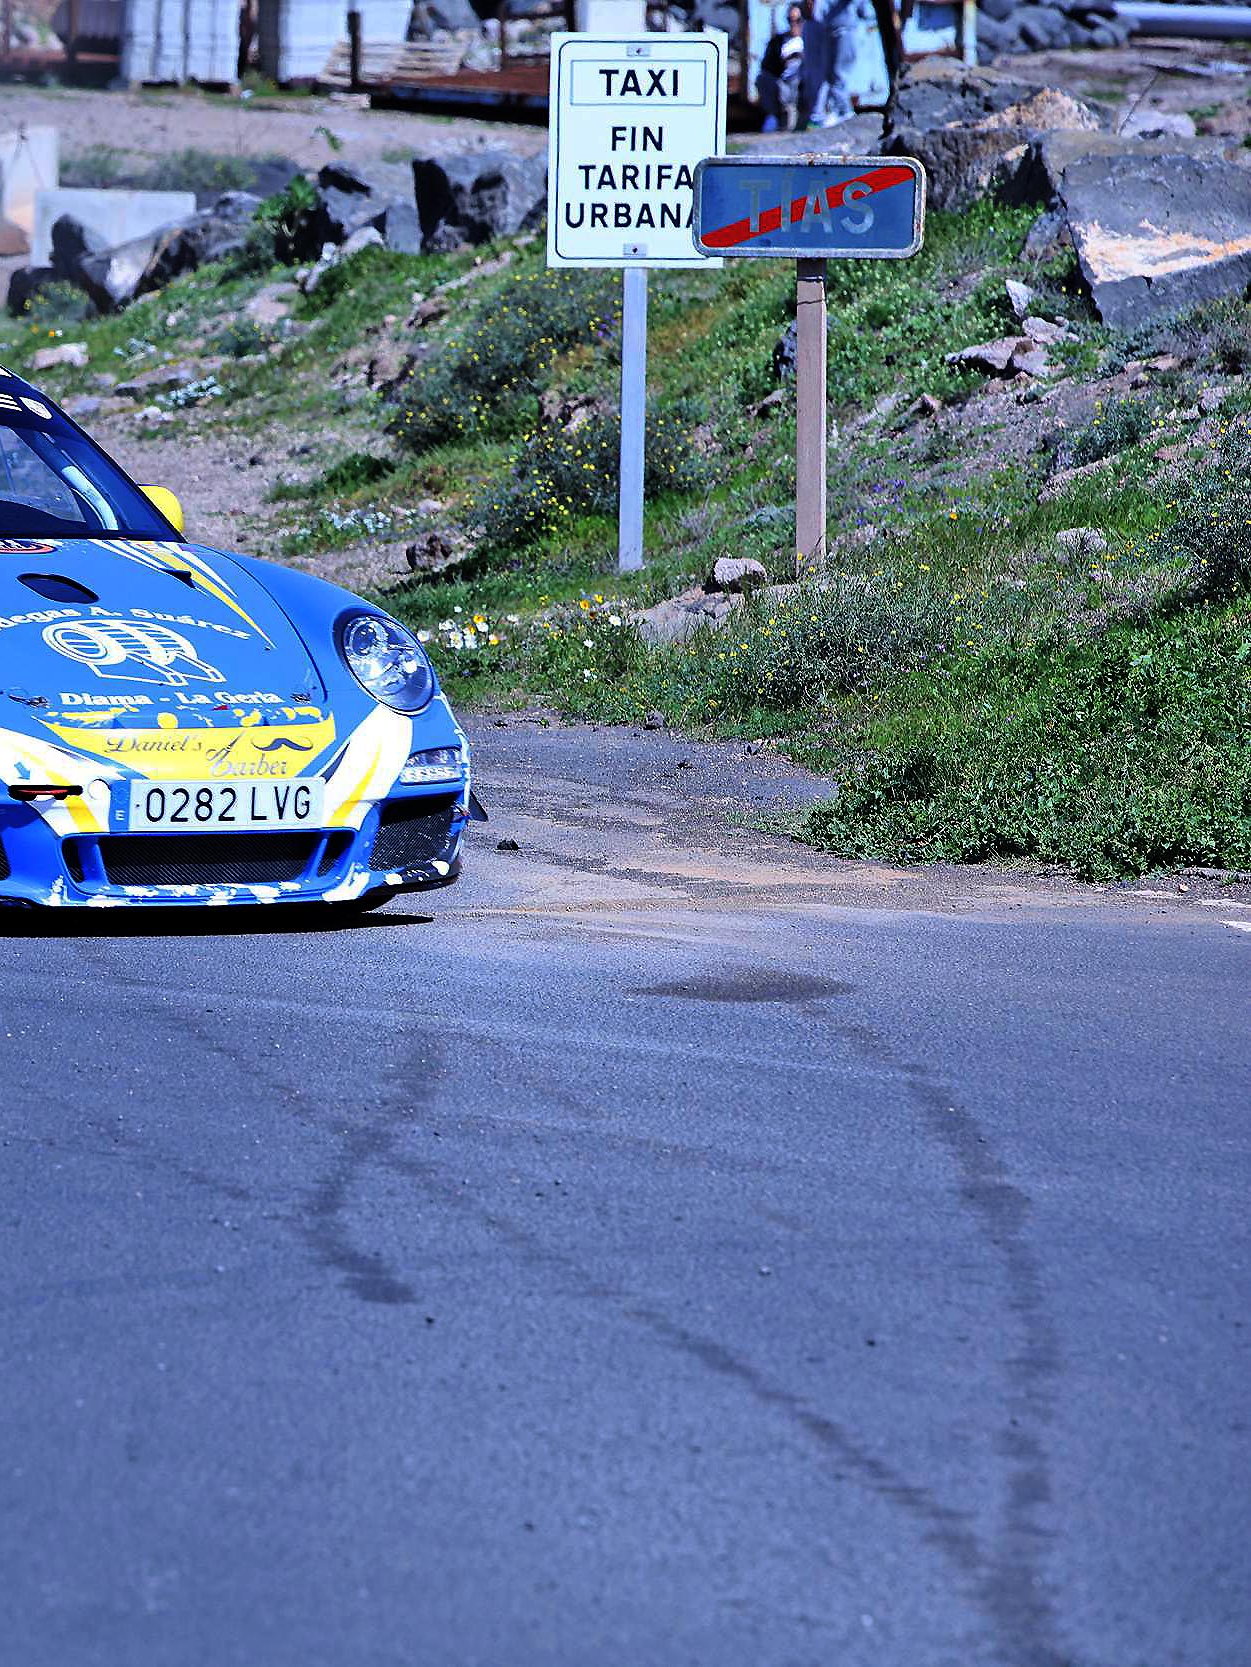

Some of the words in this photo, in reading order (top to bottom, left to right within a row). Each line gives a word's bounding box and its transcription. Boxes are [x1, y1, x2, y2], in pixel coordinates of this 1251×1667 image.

[599, 69, 680, 97] TAXI
[611, 126, 663, 152] FIN
[578, 164, 694, 190] TARIFA
[90, 606, 123, 617] A.
[130, 607, 251, 640] Suárez
[59, 692, 155, 706] Diama
[174, 691, 213, 704] La
[214, 691, 282, 706] Geria
[105, 735, 203, 753] Daniel's
[115, 809, 125, 821] E
[146, 788, 237, 822] 0282
[251, 785, 311, 821] LVG
